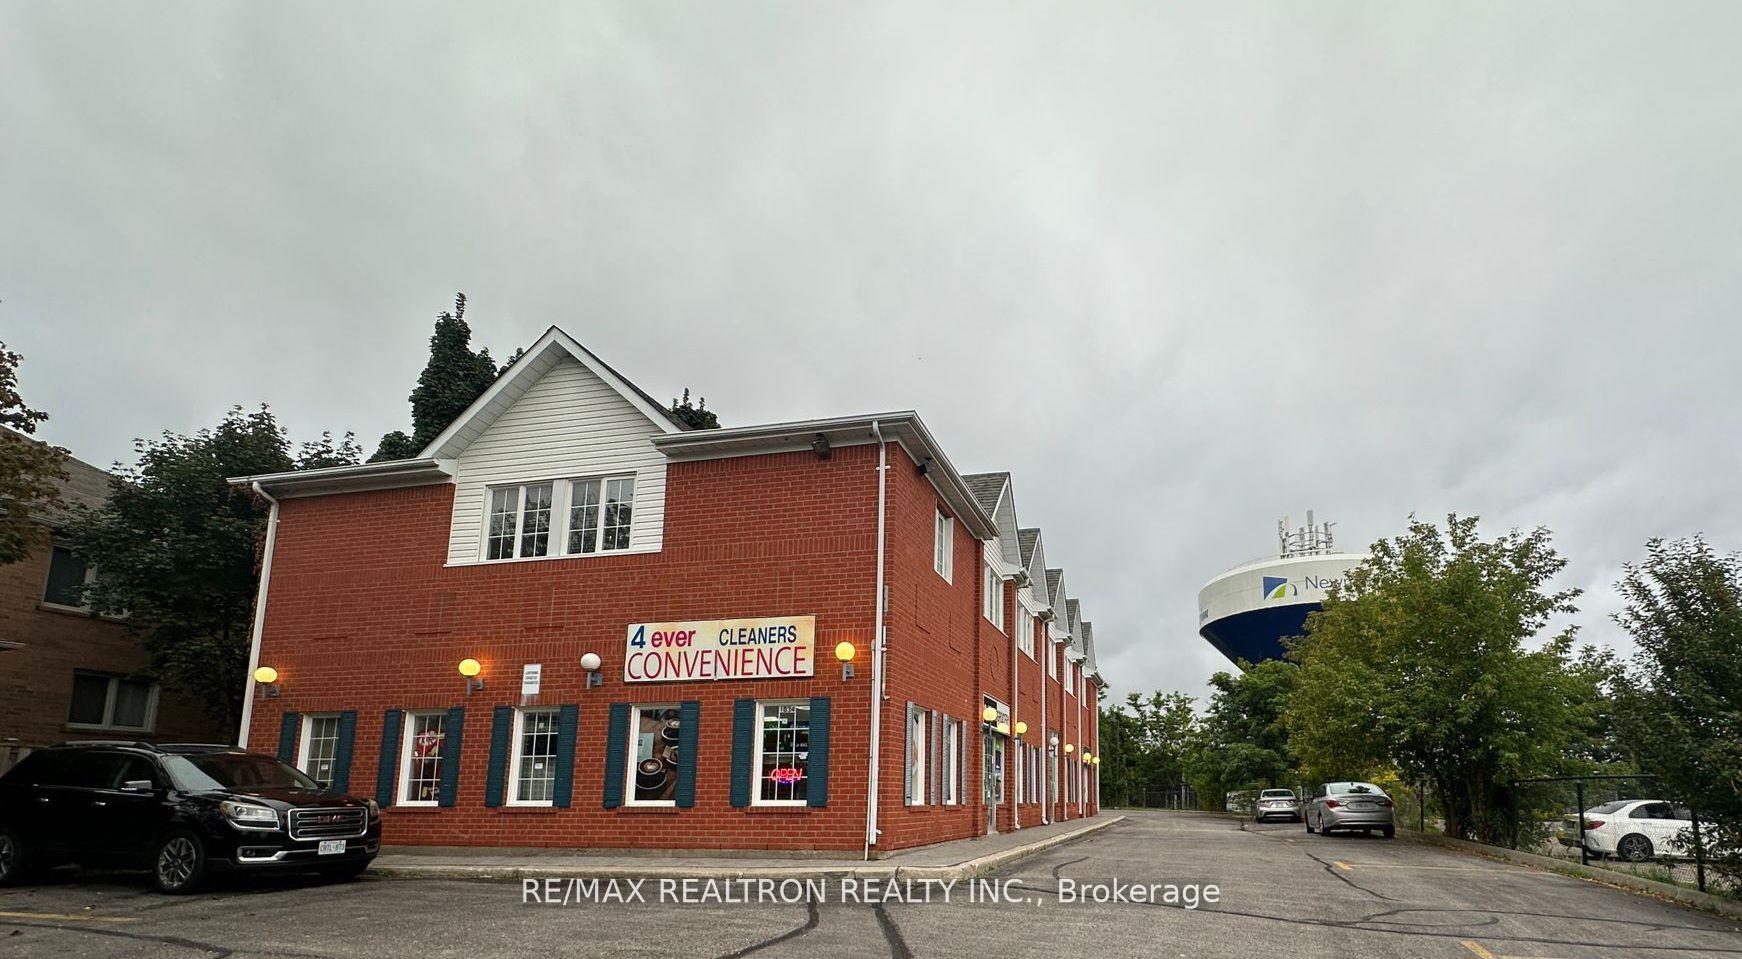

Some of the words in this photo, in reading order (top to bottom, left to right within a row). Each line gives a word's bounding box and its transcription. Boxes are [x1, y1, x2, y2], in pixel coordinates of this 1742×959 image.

[630, 625, 646, 648] 4
[651, 629, 697, 648] ever
[718, 625, 797, 646] CLEANERS
[627, 646, 807, 679] CONVENIENCE
[771, 768, 803, 781] OPEN
